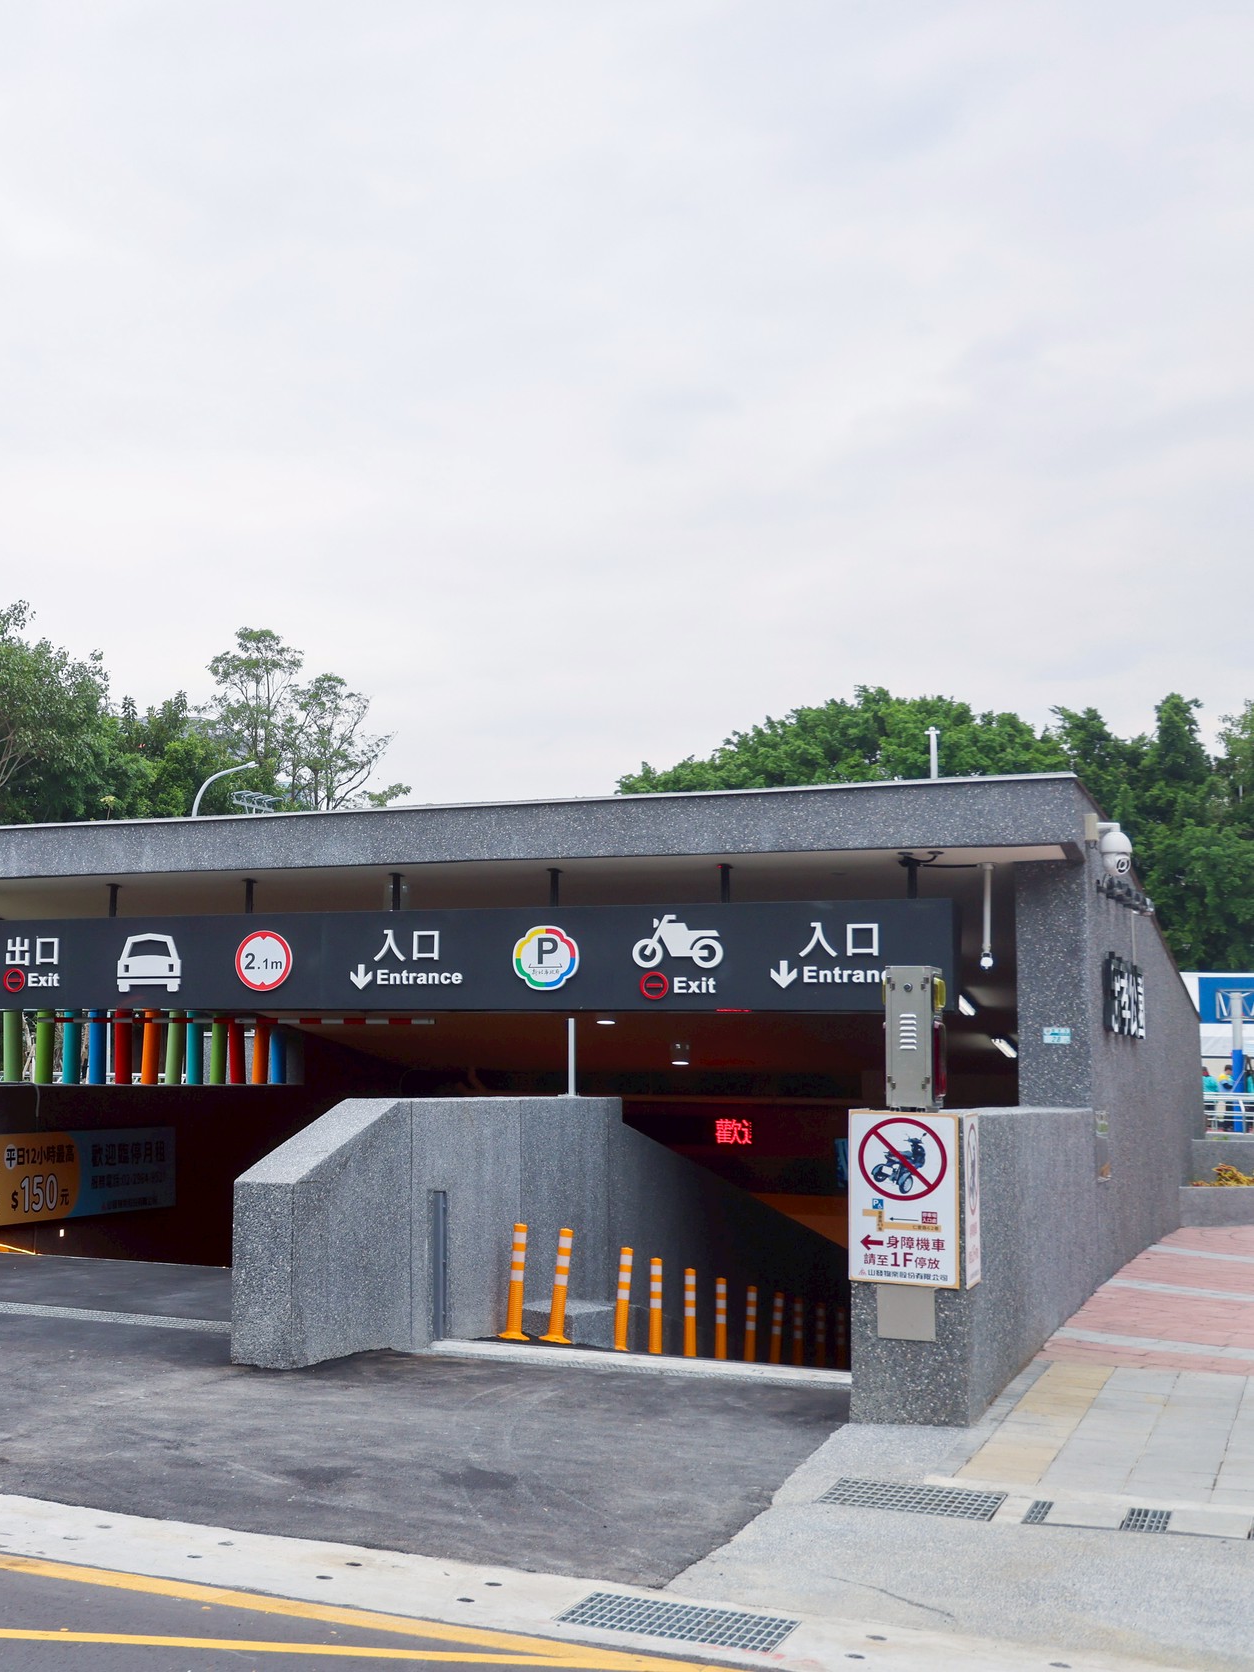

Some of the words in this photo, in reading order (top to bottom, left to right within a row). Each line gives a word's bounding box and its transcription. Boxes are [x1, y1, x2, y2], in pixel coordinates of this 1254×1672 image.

[373, 930, 440, 962] 入口
[798, 922, 879, 957] 入口
[5, 936, 60, 966] 出口
[537, 937, 558, 965] P
[244, 952, 283, 970] 2.1m
[27, 972, 61, 988] Exit
[376, 968, 463, 986] Entrance
[803, 966, 886, 983] Entran
[672, 976, 716, 995] Exit
[6, 1143, 74, 1168] 平日12小時最高
[11, 1173, 70, 1213] $150元
[886, 1236, 946, 1252] 身障機車
[863, 1252, 940, 1270] 請至1F停放
